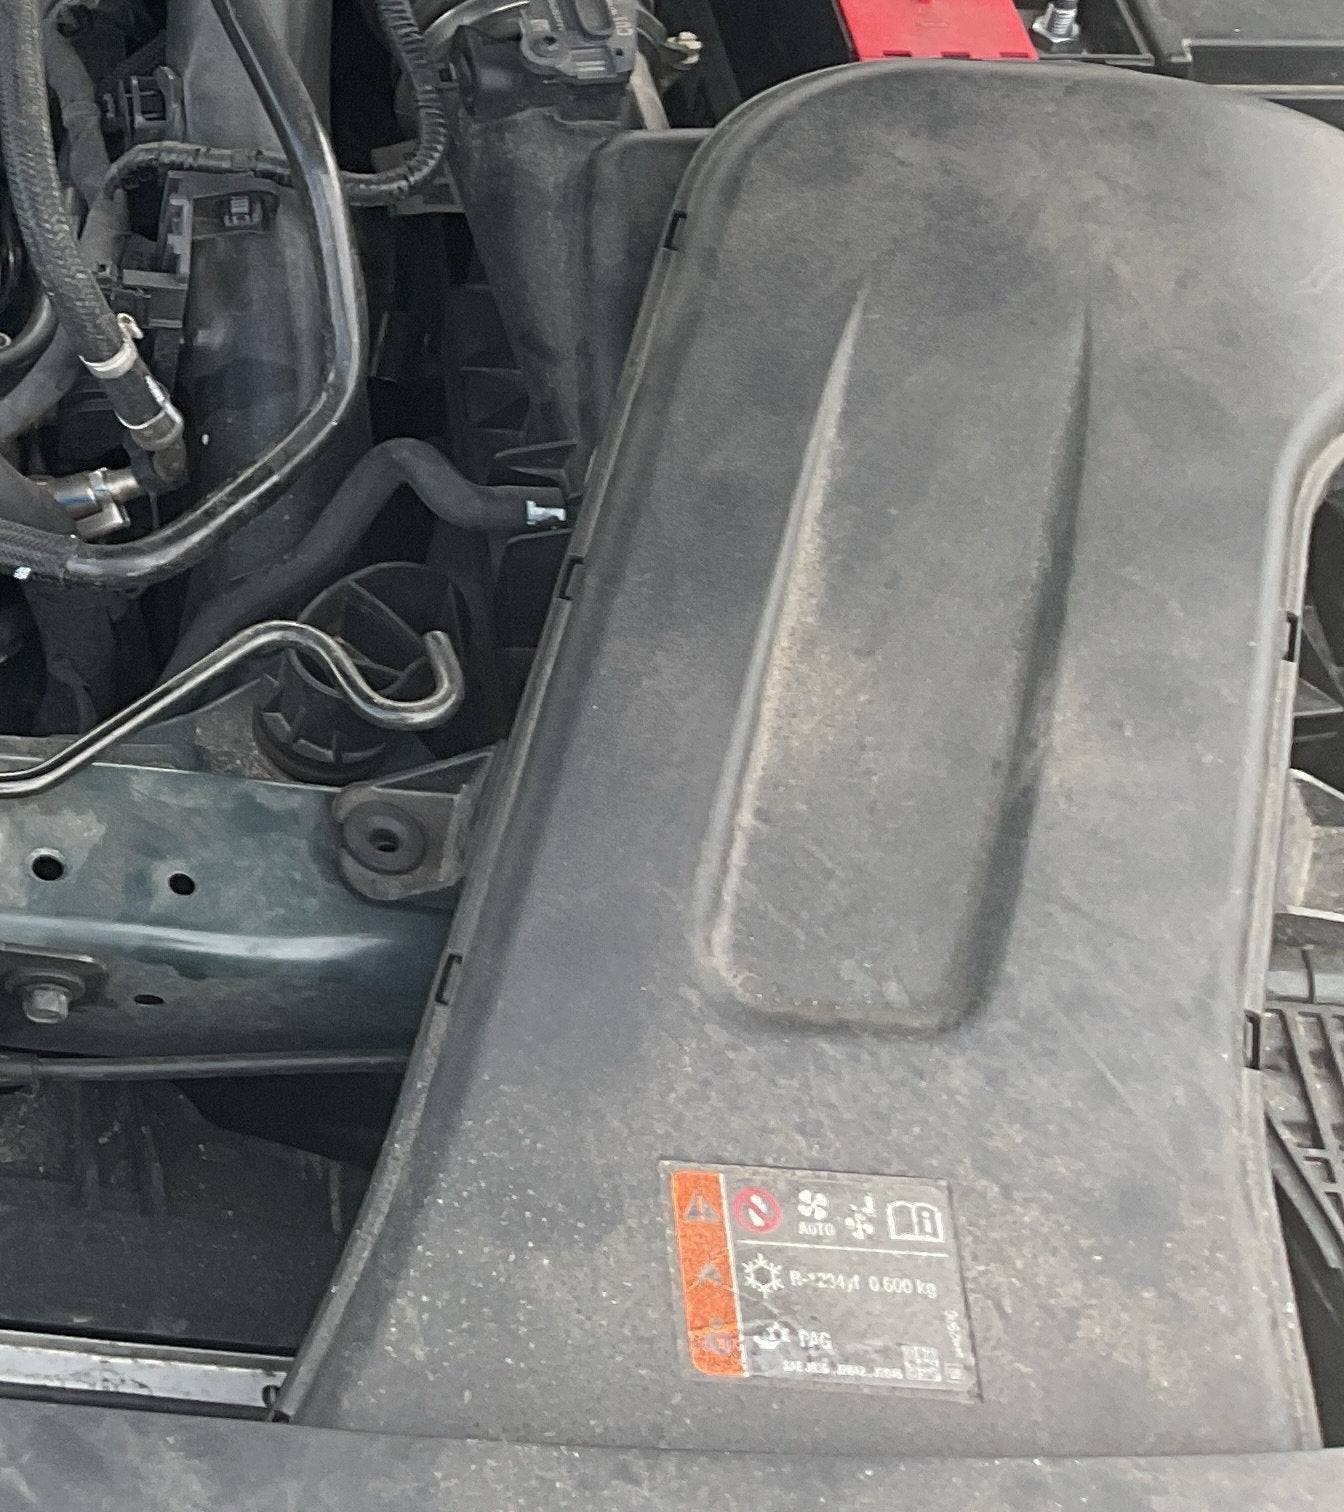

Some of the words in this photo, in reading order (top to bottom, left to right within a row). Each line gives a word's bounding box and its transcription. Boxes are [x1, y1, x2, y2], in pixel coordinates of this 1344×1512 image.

[798, 1220, 836, 1236] AUTO
[915, 1278, 938, 1299] kg
[798, 1328, 833, 1351] PAG
